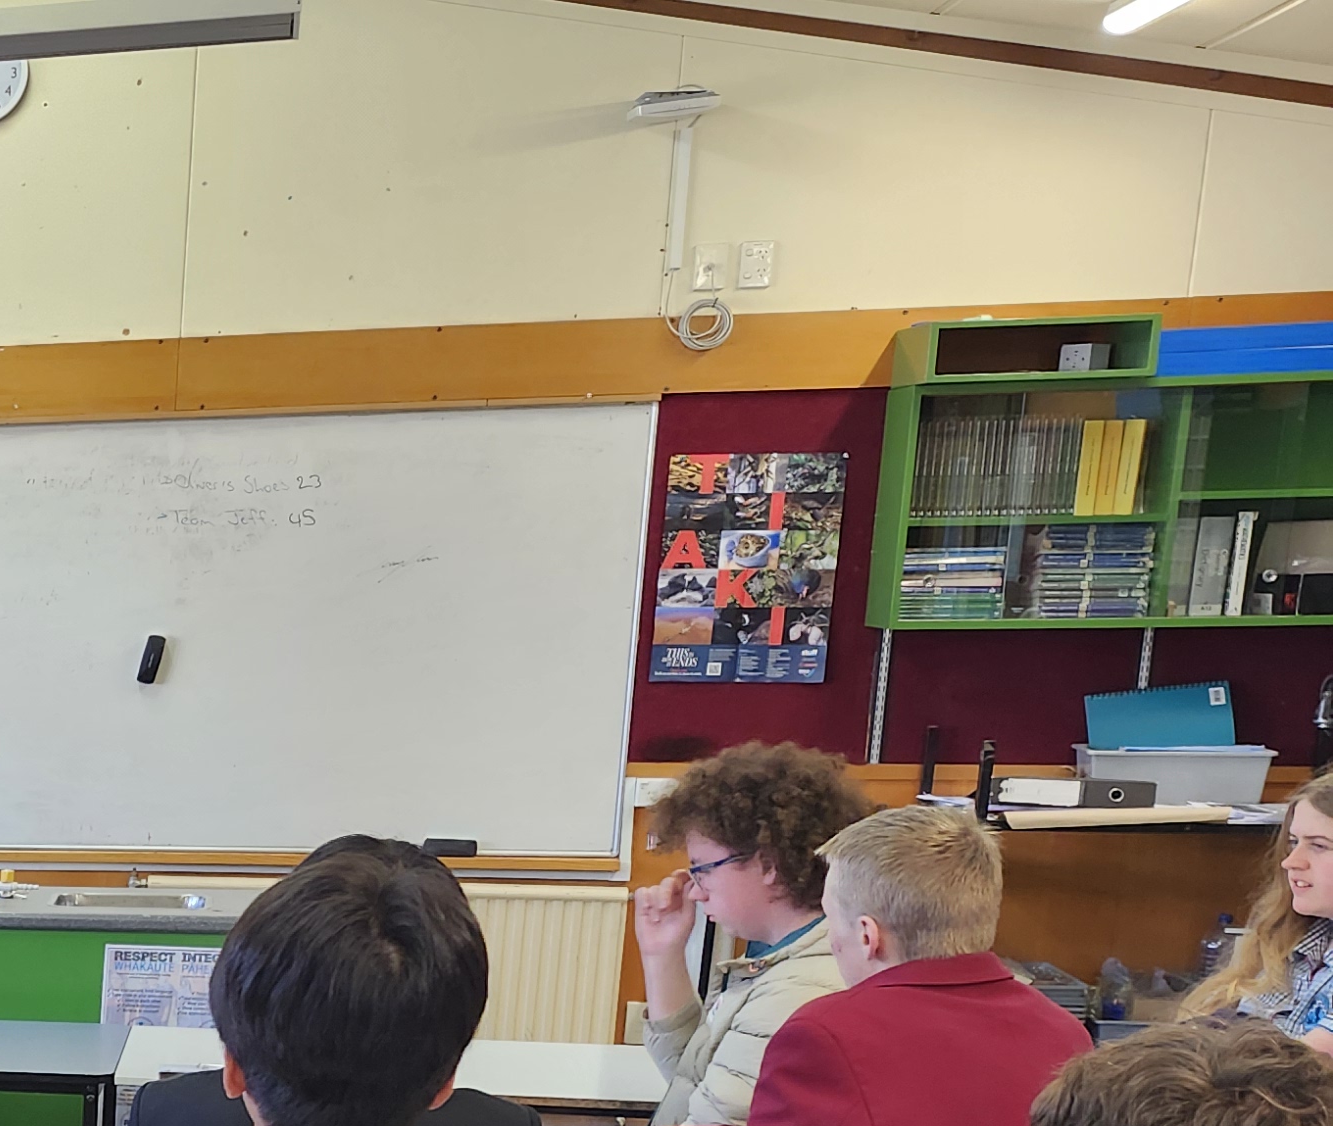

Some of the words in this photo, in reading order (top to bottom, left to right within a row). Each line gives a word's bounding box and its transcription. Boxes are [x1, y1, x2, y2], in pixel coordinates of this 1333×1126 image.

[11, 67, 17, 79] 3
[5, 85, 12, 96] 4
[296, 474, 322, 490] 23
[114, 950, 176, 963] RESPECT
[114, 962, 175, 973] WHAKAUTE
